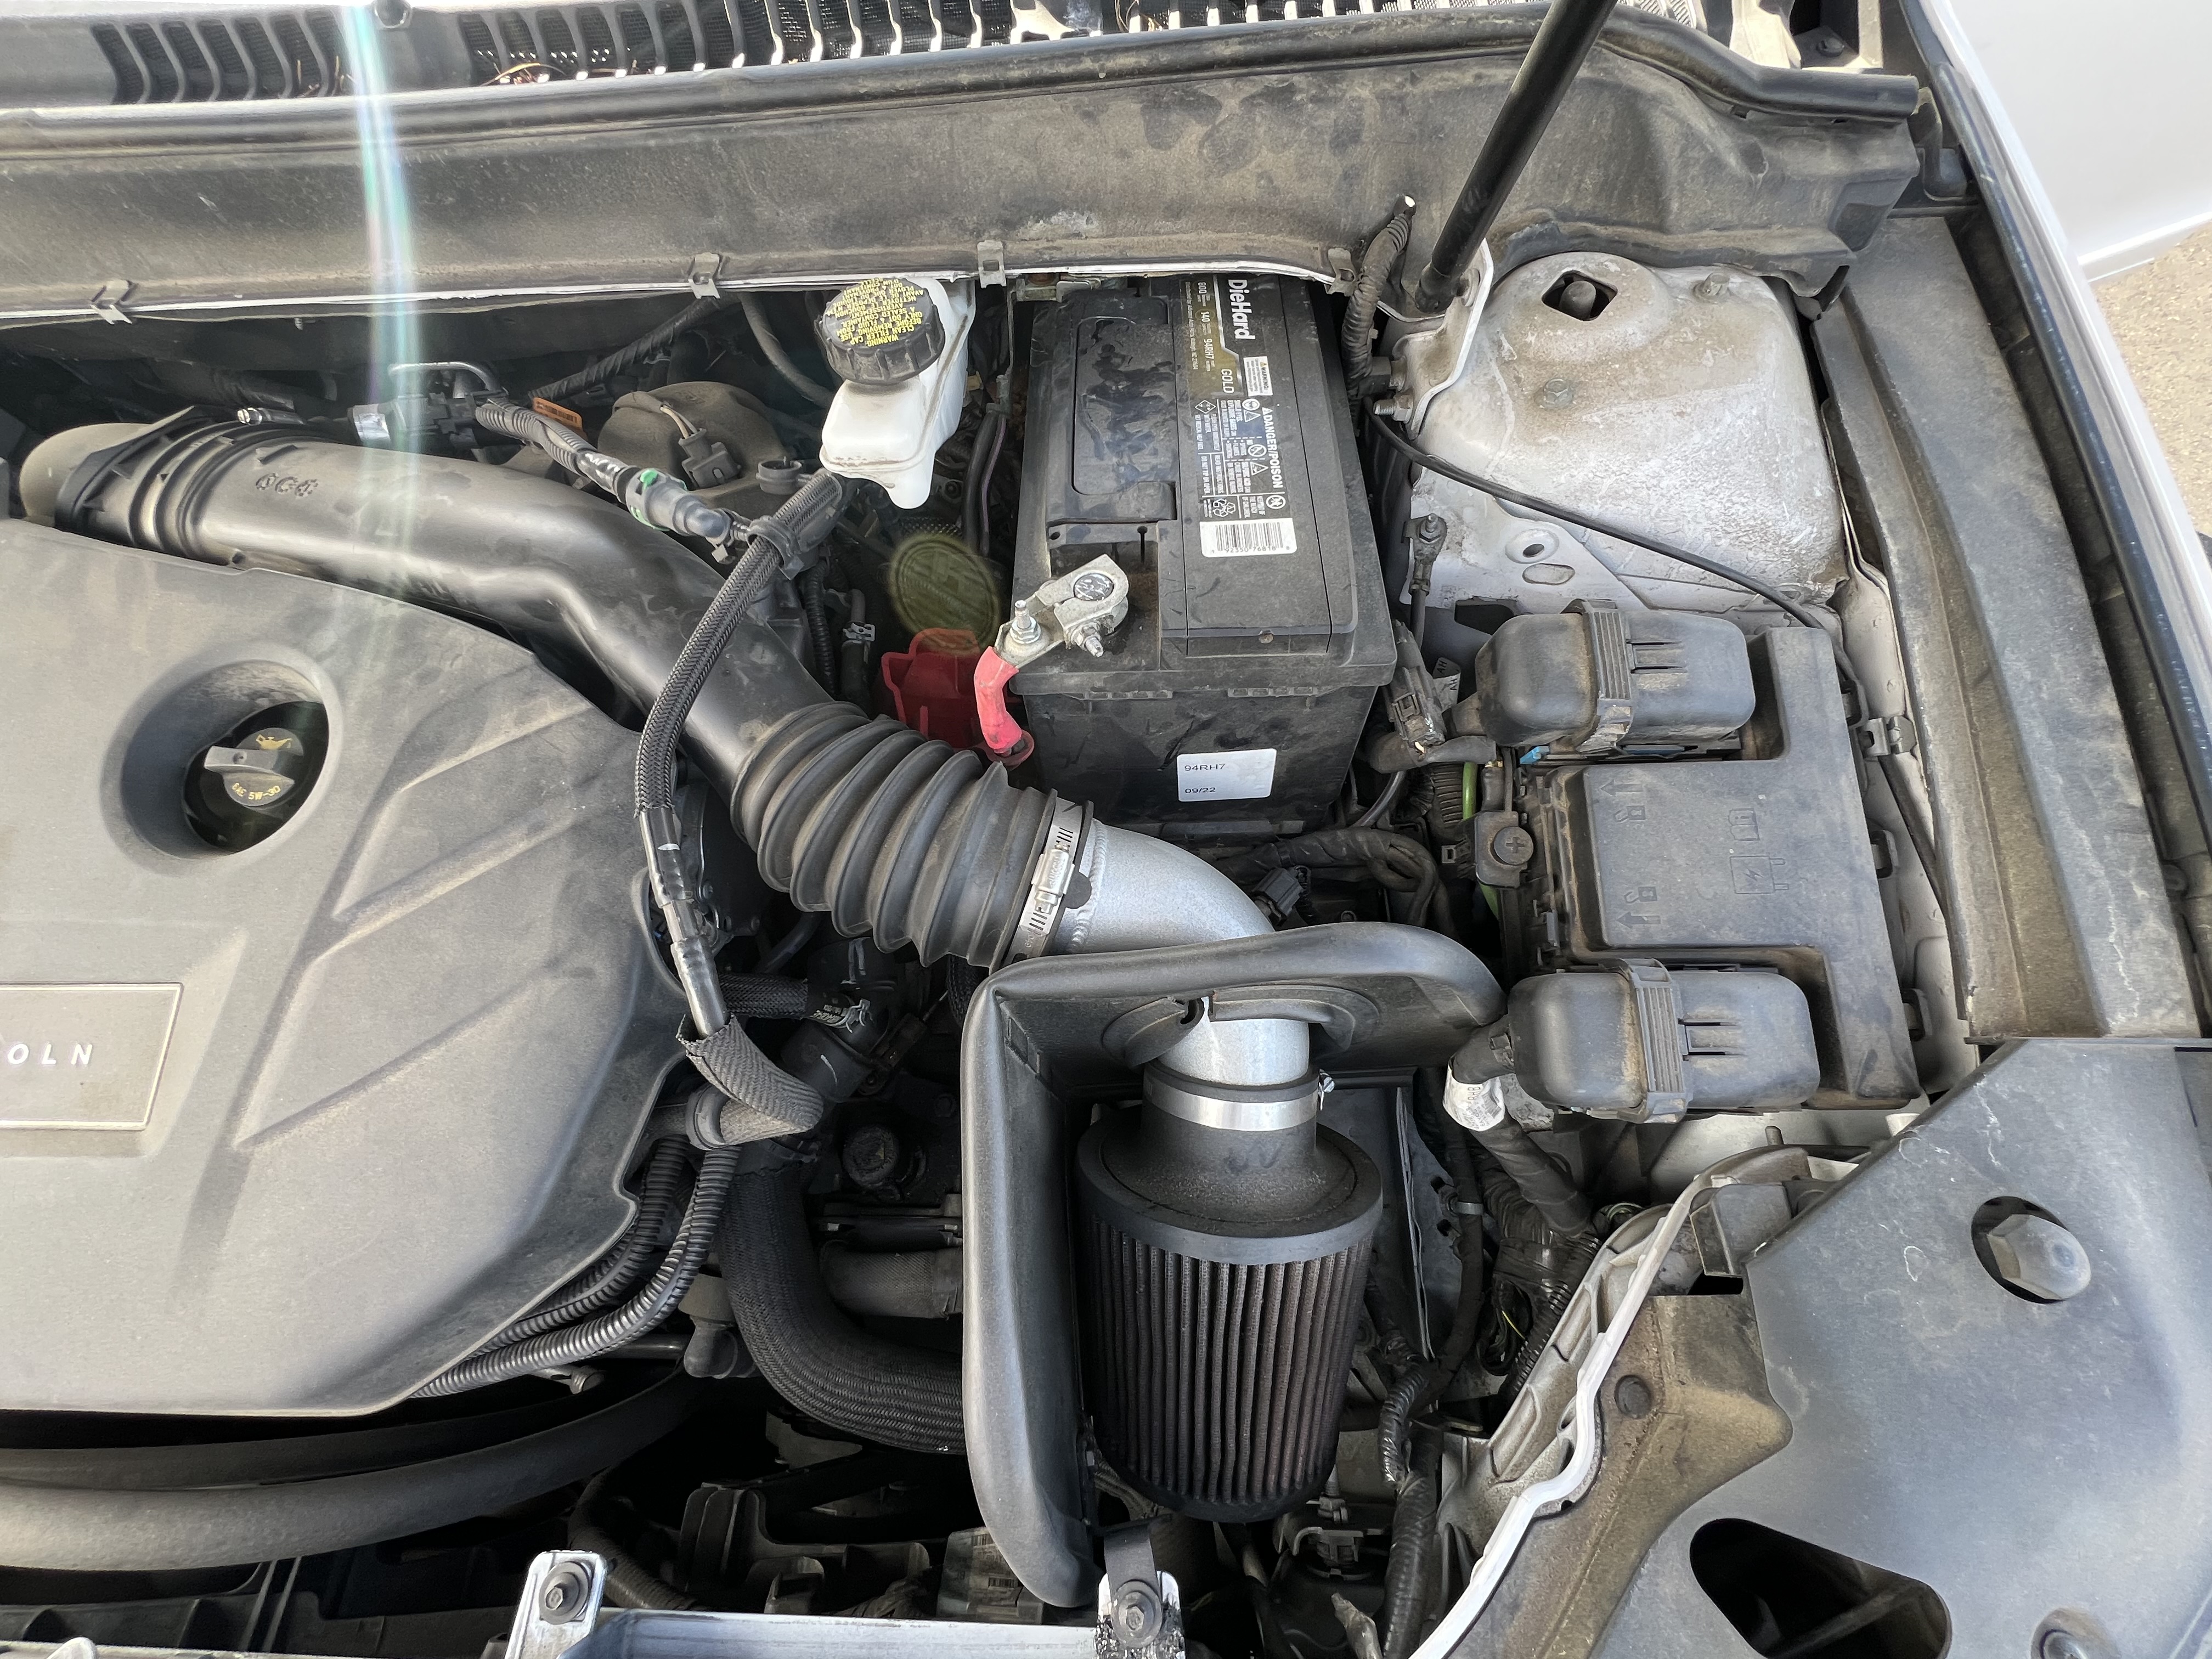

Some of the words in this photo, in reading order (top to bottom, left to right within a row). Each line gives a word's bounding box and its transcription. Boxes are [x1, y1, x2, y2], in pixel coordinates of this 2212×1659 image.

[844, 283, 880, 295] CONTENANT
[889, 286, 914, 294] PLOYER
[1198, 282, 1207, 294] 800
[842, 287, 879, 301] PROVENANT
[833, 297, 857, 307] LIQUIDE
[882, 296, 916, 305] NETTOYER
[835, 306, 866, 318] BOUCHON
[882, 308, 907, 317] SEALED
[1228, 279, 1256, 340] DieHard
[841, 313, 878, 327] CONTAINER.
[895, 318, 922, 327] BEFORE
[1201, 312, 1210, 322] 140
[858, 319, 877, 328] FLUID
[836, 325, 855, 336] FROM
[866, 329, 889, 340] FILLER
[892, 325, 914, 334] CLEAN
[840, 332, 853, 342] USE
[850, 336, 863, 345] CAP
[865, 334, 899, 347] WARNING:
[1204, 338, 1215, 359] 94RH7
[1221, 369, 1234, 393] GOLD
[1263, 415, 1283, 488] DANGER/POISON
[1184, 763, 1226, 771] 94RH7
[248, 785, 281, 800] 5W-30
